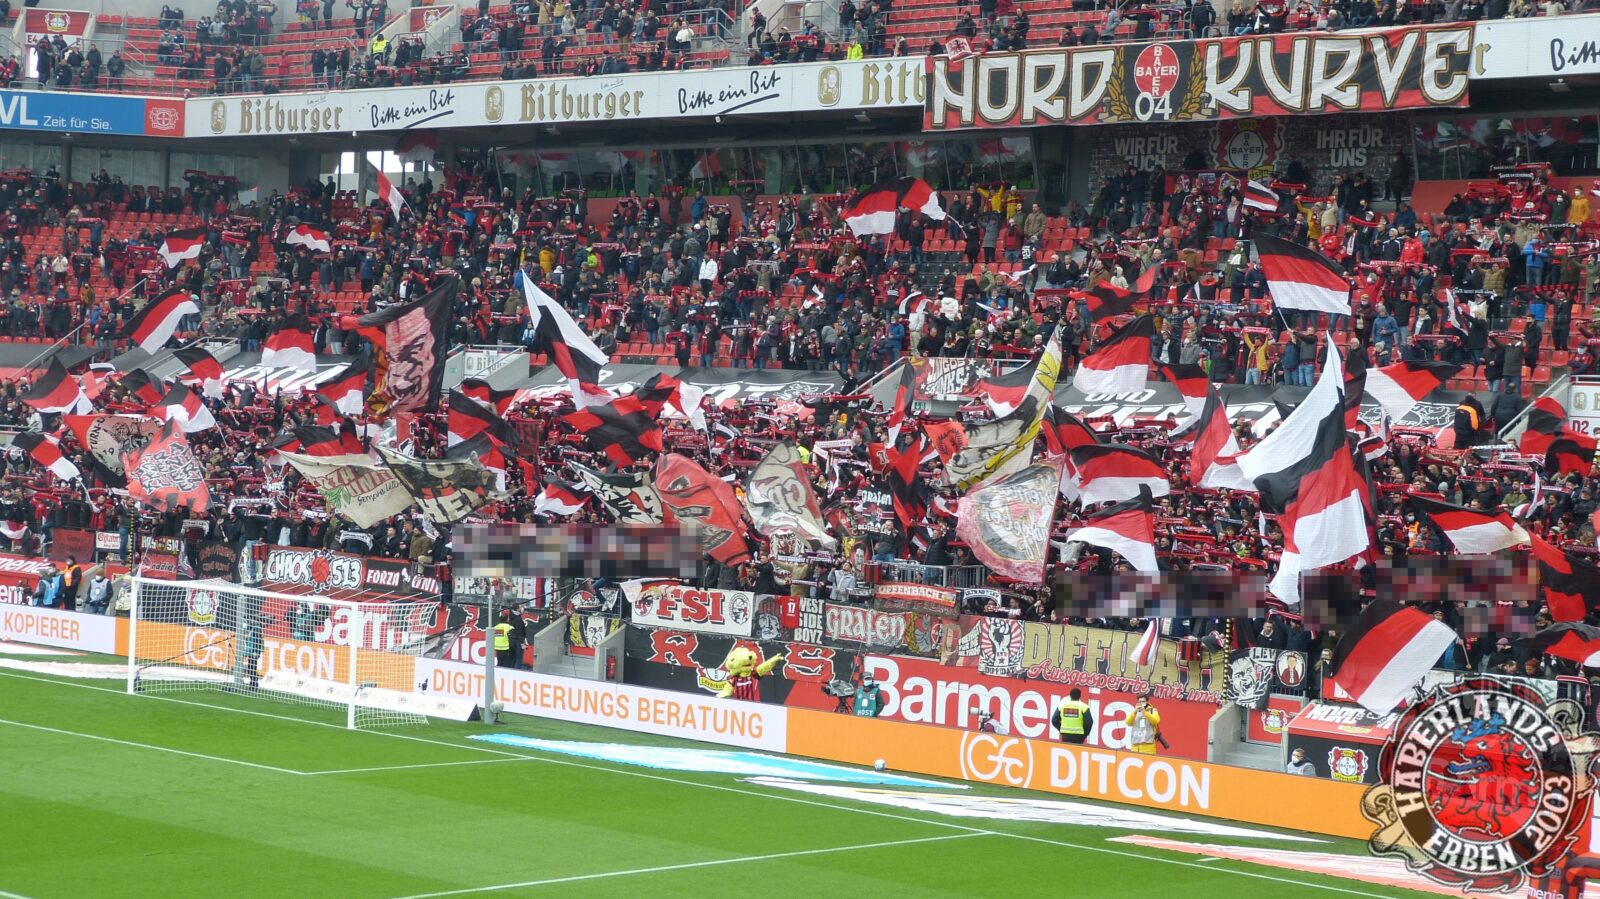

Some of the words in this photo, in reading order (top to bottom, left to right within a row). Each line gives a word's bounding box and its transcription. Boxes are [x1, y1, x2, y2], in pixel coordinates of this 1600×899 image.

[1135, 66, 1177, 77] BAYER
[1205, 28, 1471, 113] KURVE
[371, 104, 401, 128] Bitte
[404, 104, 428, 118] ein
[429, 89, 456, 111] Bit
[519, 82, 645, 122] Bitburger
[678, 88, 715, 114] Bitte
[718, 86, 747, 102] ein
[749, 70, 781, 95] Bit
[1134, 90, 1173, 120] 04
[43, 115, 67, 128] Zeit
[70, 116, 88, 129] für
[90, 118, 113, 131] Sie.
[239, 98, 343, 133] Bitburger
[1114, 137, 1147, 156] WIR
[1148, 133, 1179, 155] FÜR
[1316, 129, 1346, 149] IHR
[1348, 124, 1385, 148] FÜR
[1330, 148, 1368, 167] UNS
[329, 556, 363, 590] 513
[366, 569, 400, 587] FORZA
[656, 583, 726, 624] FSI
[3, 611, 81, 642] KOPIERER
[637, 696, 764, 740] BERATUNG
[1050, 747, 1210, 809] DITCON
